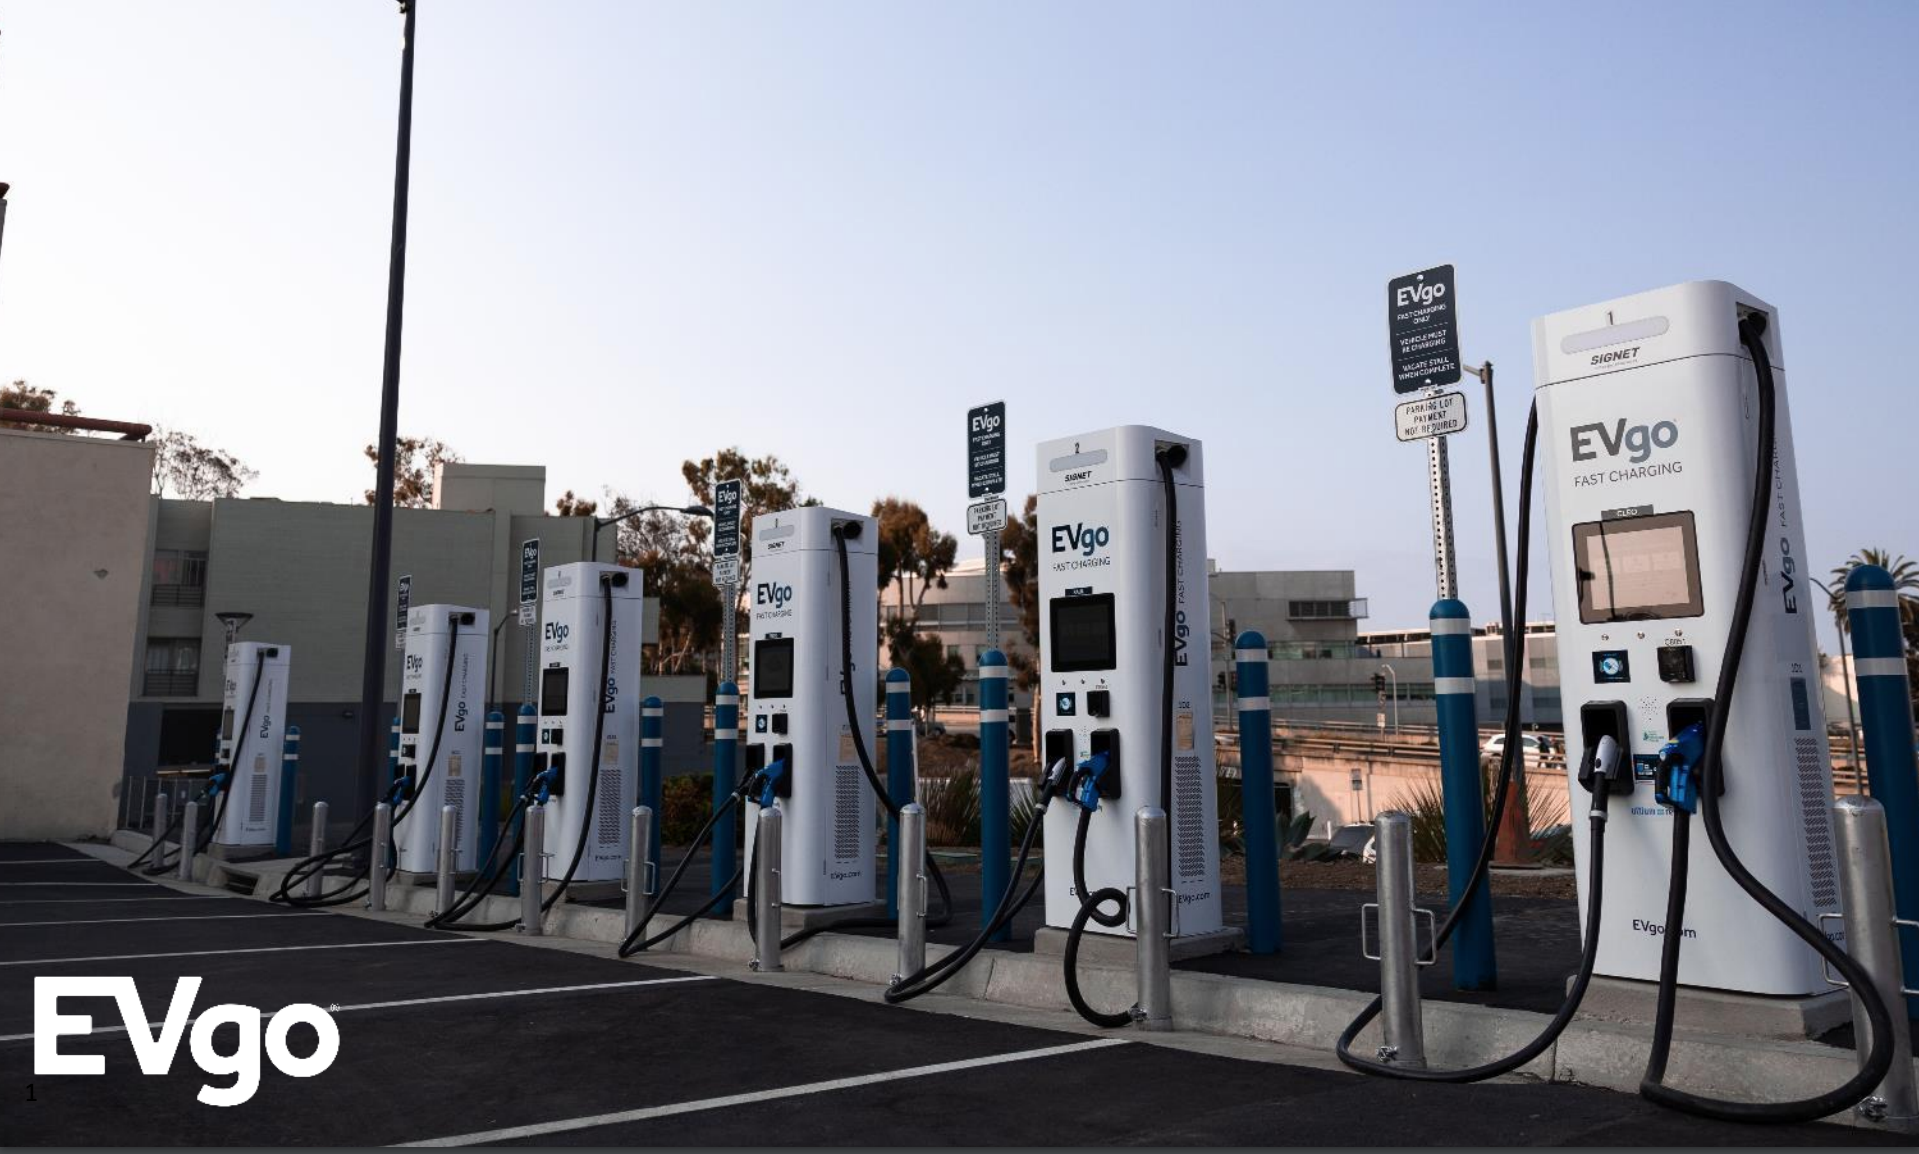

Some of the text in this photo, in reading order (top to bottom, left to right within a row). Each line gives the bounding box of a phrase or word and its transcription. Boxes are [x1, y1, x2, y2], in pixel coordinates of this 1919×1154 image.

[1397, 282, 1446, 307] EVgo
[1413, 315, 1430, 325] ONLY
[1607, 311, 1615, 326] 1
[1400, 329, 1447, 346] VEHICLE MUST
[1411, 337, 1446, 351] CHARGING
[1402, 356, 1450, 372] VACATE STALL
[1590, 346, 1641, 366] SIGNET
[1398, 362, 1456, 380] WHEN COMPLETE
[1406, 398, 1454, 415] PARKING LOT
[972, 414, 1000, 432] EVgo
[1414, 410, 1447, 423] PAYMENT
[1404, 418, 1458, 436] NOT REQUIRED
[1074, 442, 1080, 454] 2
[1570, 418, 1679, 464] EVgo
[1064, 470, 1092, 482] SIGNET
[1574, 461, 1683, 488] FAST CHARGING
[718, 490, 737, 504] EVgo
[1776, 492, 1788, 528] FAST
[1051, 522, 1109, 556] EVgo
[1053, 556, 1111, 572] FAST CHARGING
[1780, 536, 1798, 614] EVgo
[757, 582, 792, 608] EVgo
[1178, 578, 1186, 604] FAST
[545, 622, 570, 643] EVgo
[1174, 610, 1192, 667] EVgo
[406, 655, 423, 672] EVgo
[604, 678, 618, 714] EVgo
[455, 702, 468, 732] EVgo
[260, 715, 271, 739] EVgo
[1632, 919, 1697, 938] EVgom
